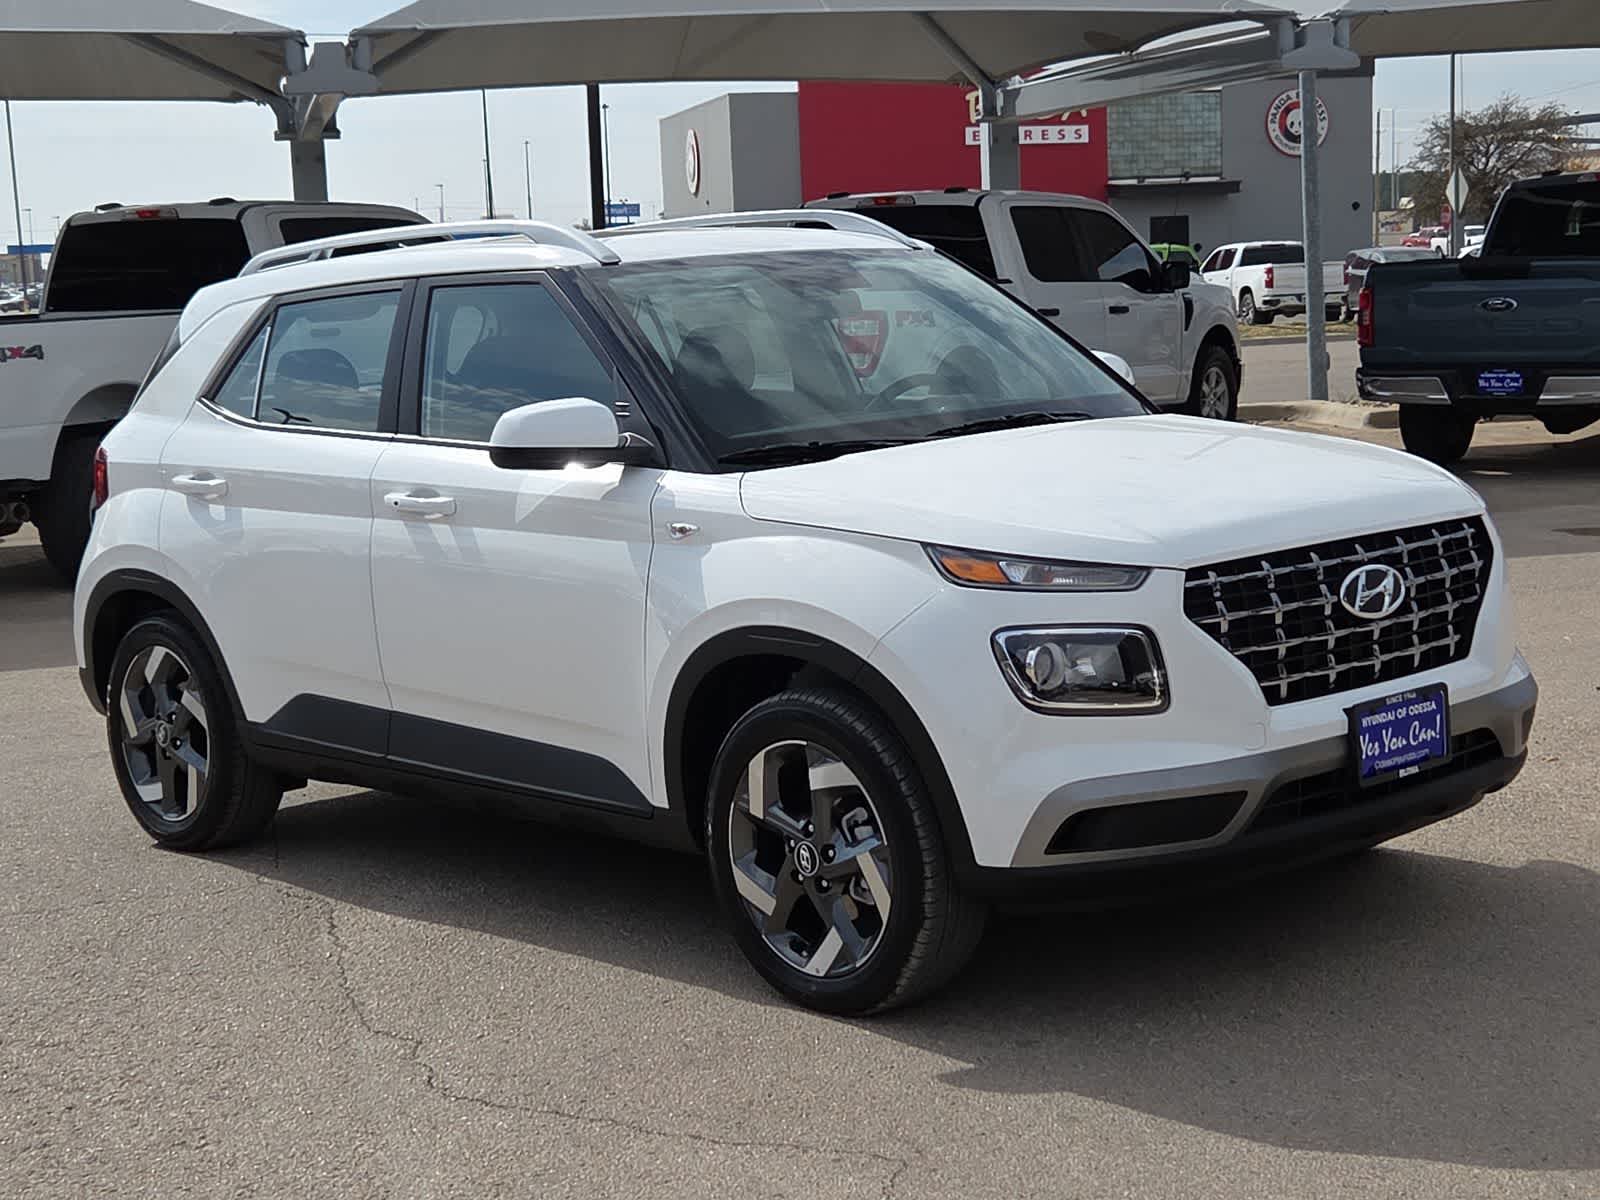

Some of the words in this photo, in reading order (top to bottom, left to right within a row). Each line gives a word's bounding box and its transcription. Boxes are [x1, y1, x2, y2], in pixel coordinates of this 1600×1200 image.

[1269, 94, 1293, 125] PANDA
[972, 128, 1083, 141] ERESS
[1361, 710, 1395, 728] HYUNDAI
[1396, 706, 1407, 719] OF
[1408, 700, 1437, 716] ODESSA
[1360, 733, 1380, 760] Yes
[1382, 727, 1407, 753] You
[1409, 714, 1441, 746] Can!
